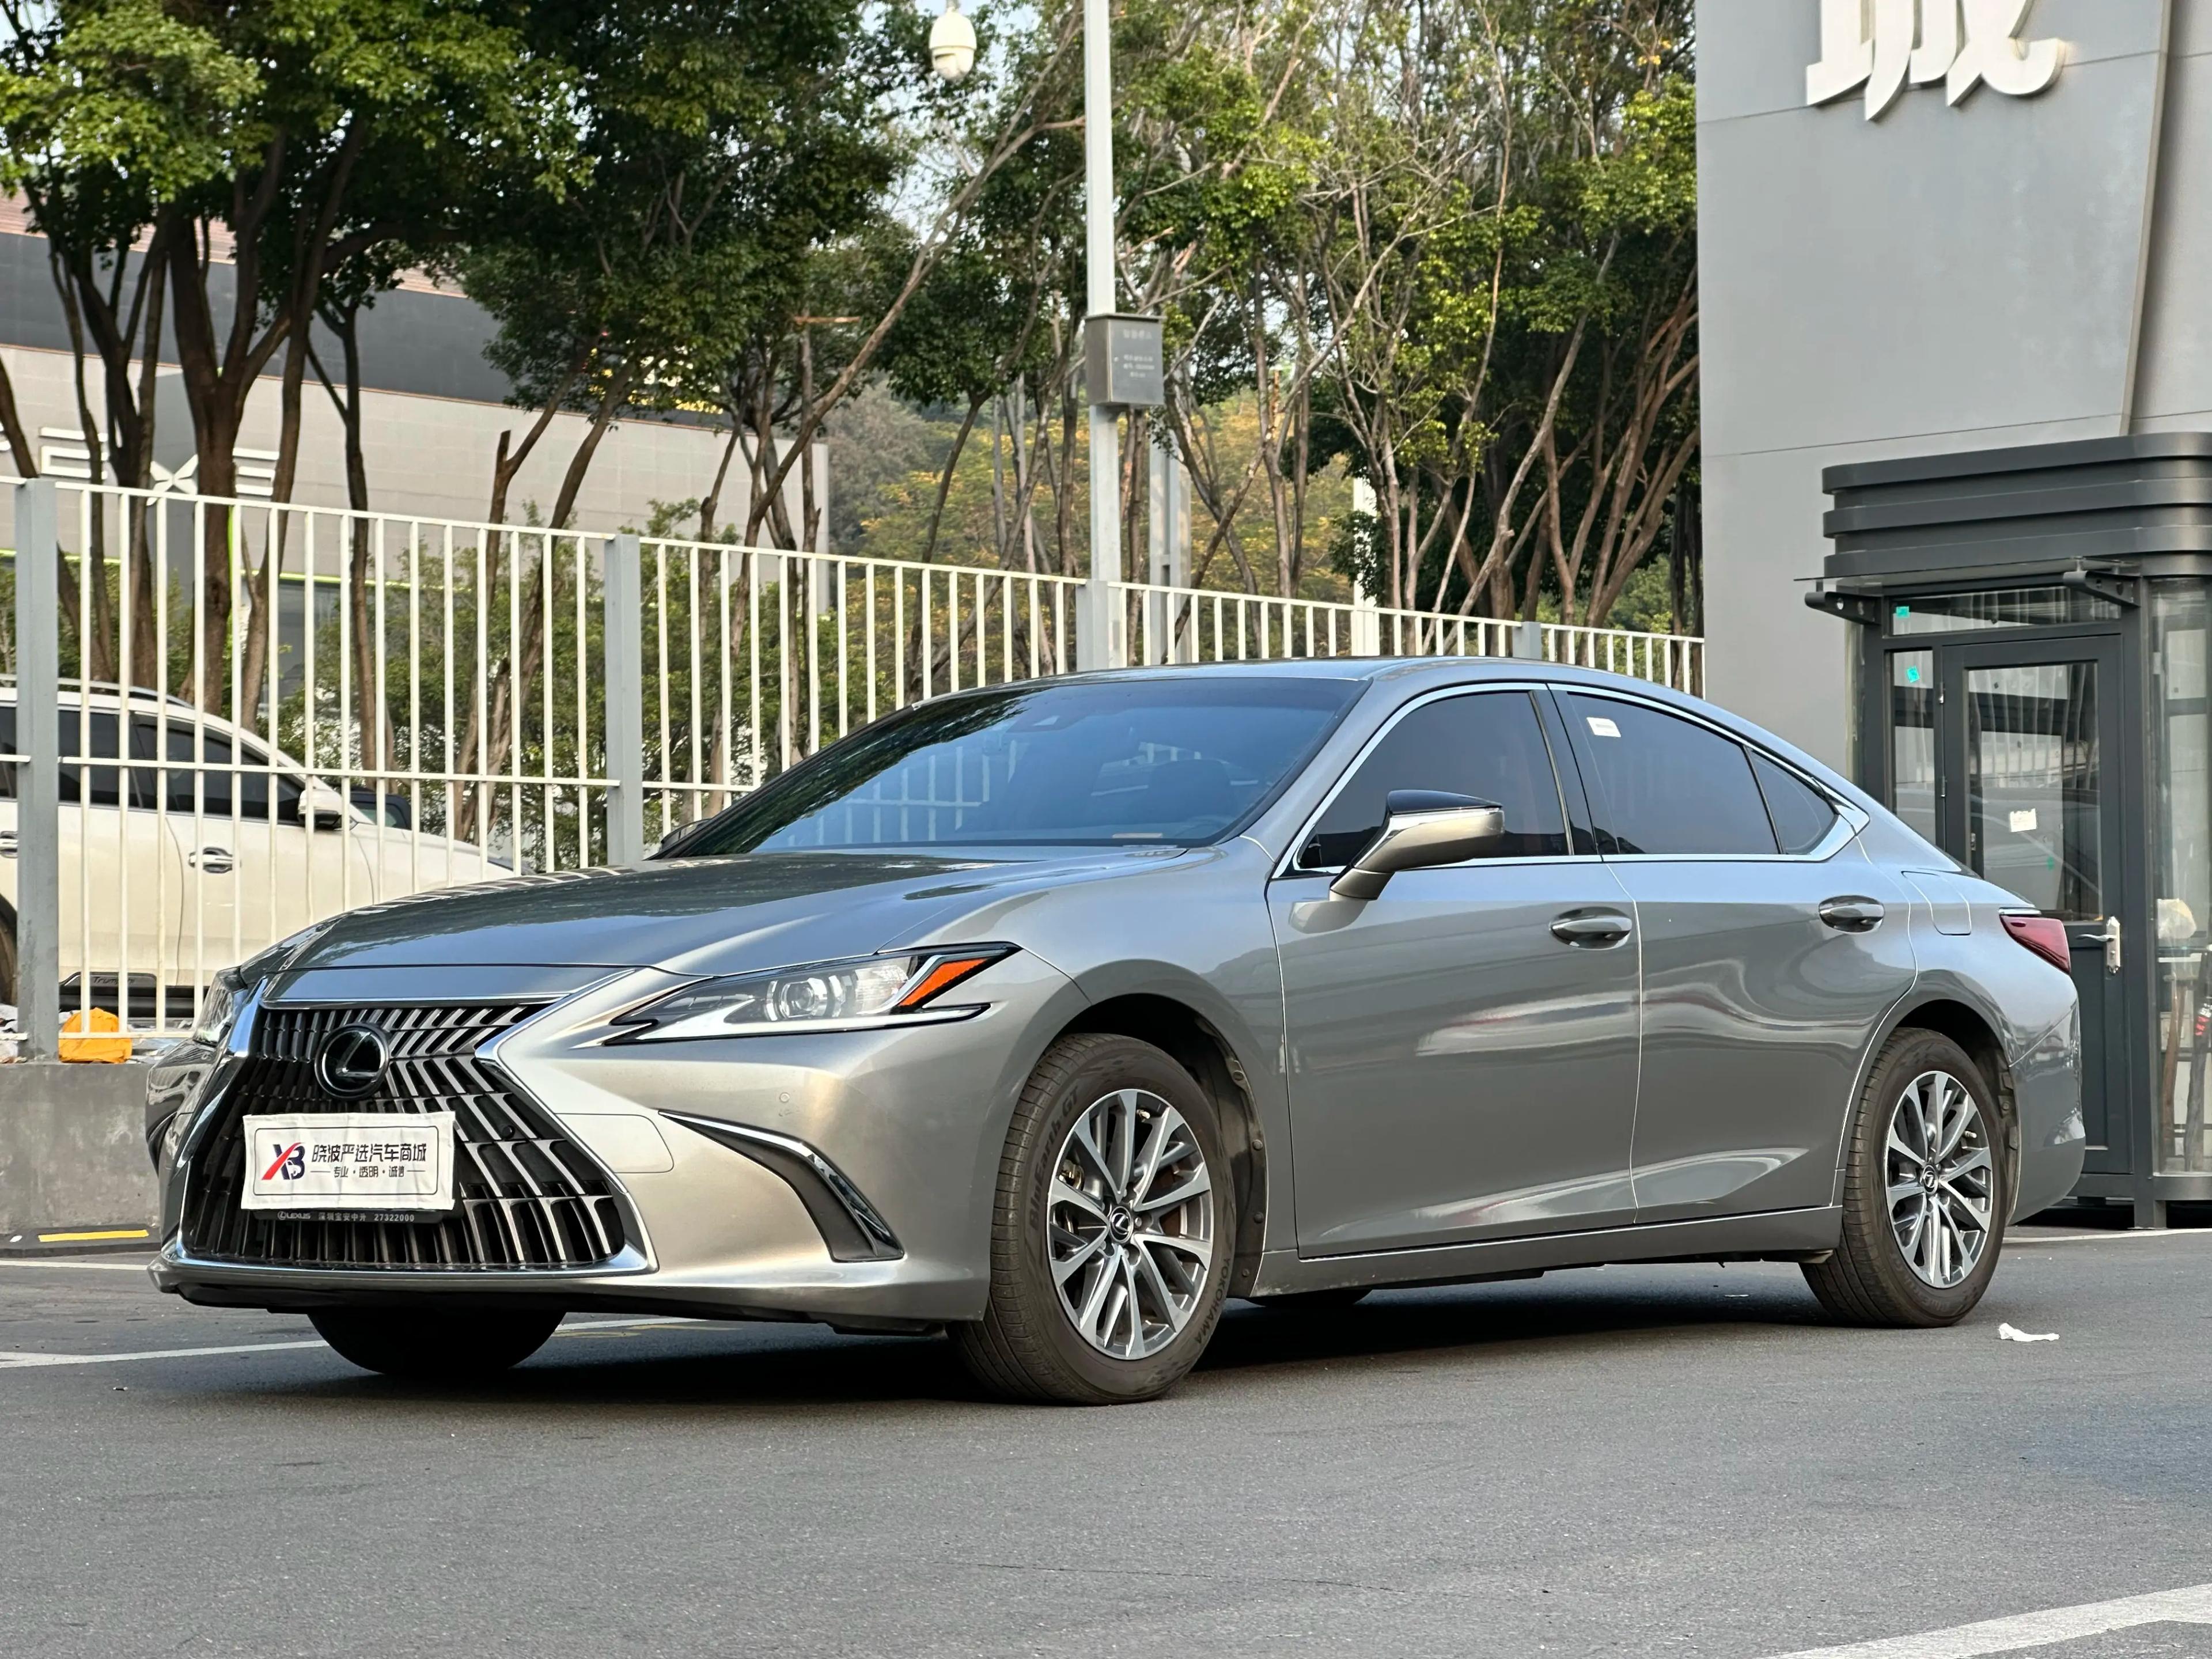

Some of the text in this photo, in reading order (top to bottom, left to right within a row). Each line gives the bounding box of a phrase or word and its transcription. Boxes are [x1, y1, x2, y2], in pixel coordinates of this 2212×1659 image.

[311, 1143, 427, 1162] 晓波严选汽车商城
[374, 1213, 415, 1222] 27322000
[1194, 1258, 1231, 1344] YOKOHAMA
